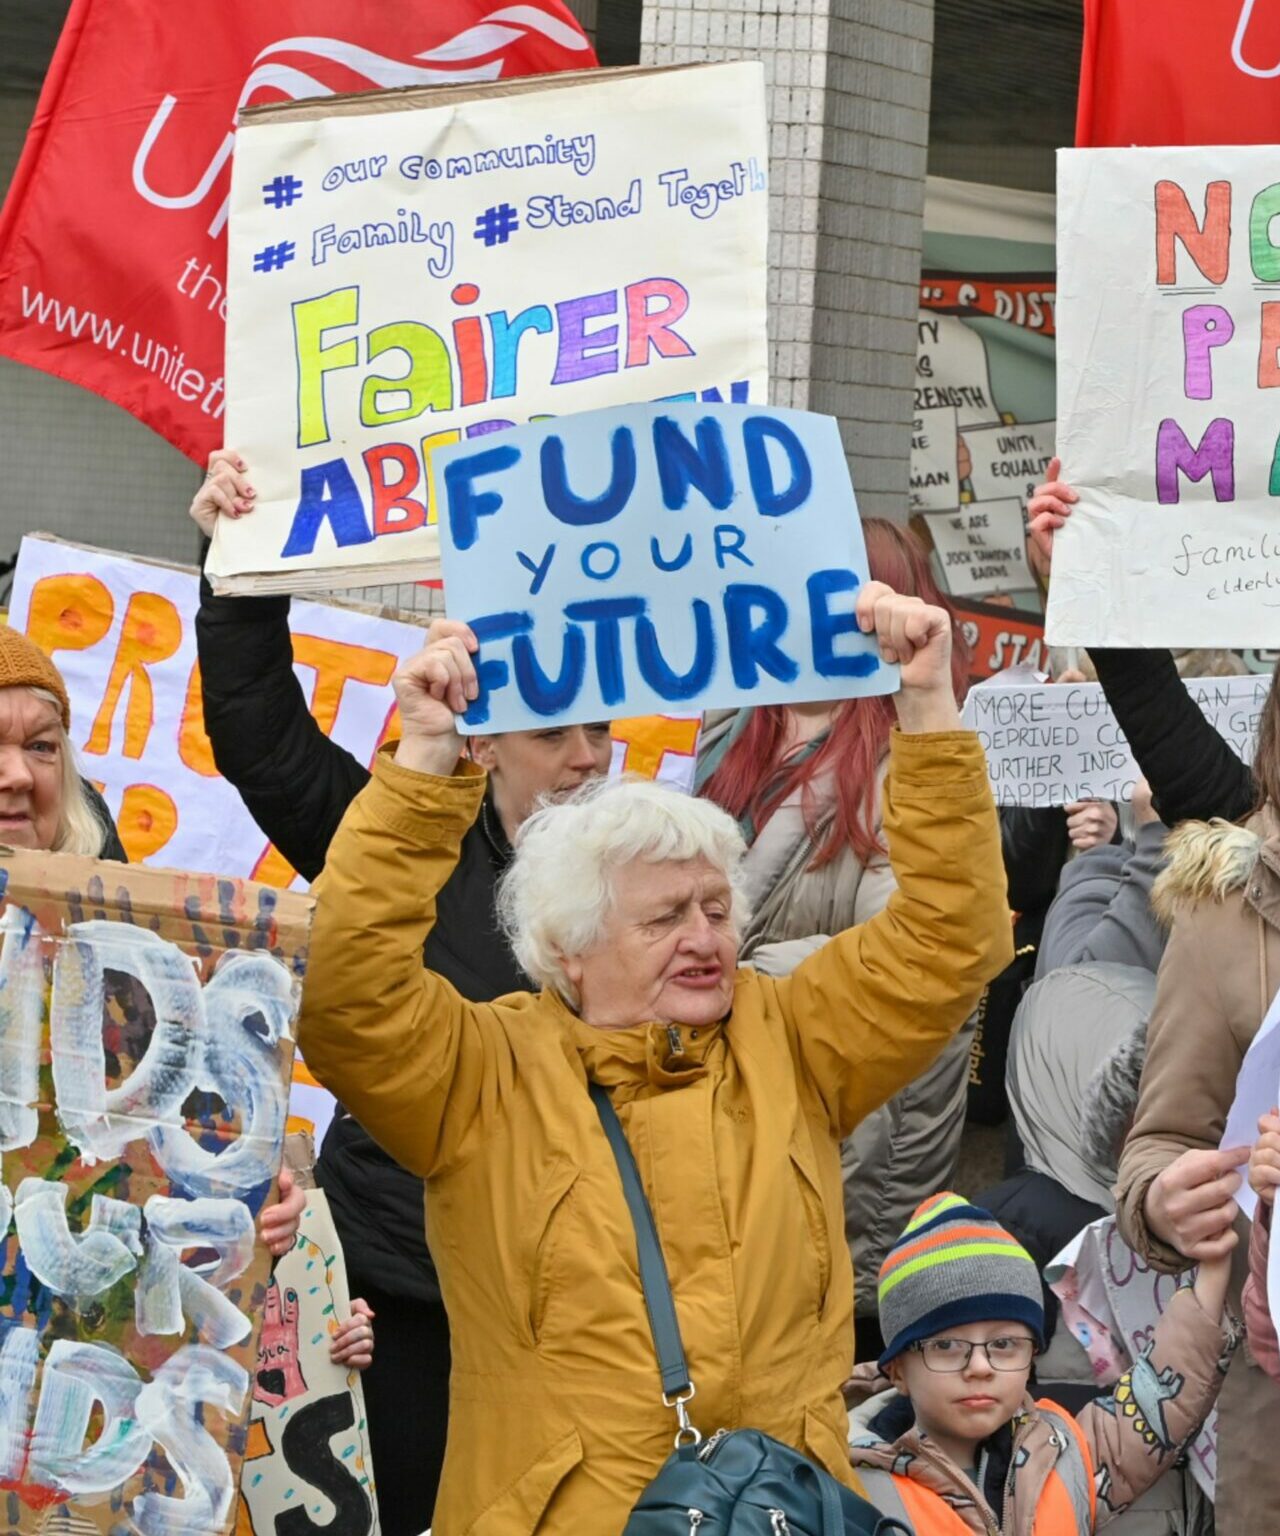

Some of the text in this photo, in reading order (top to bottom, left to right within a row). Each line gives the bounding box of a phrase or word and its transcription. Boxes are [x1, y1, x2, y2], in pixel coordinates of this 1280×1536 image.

[444, 415, 813, 550] FUND
[991, 457, 1052, 479] EQUALIT
[516, 525, 753, 595] YOUR
[463, 569, 879, 725] FUTURE
[974, 693, 1050, 727] MORE
[977, 727, 1080, 751] DEPRIVED
[986, 749, 1127, 781] URTHER INTO
[0, 1177, 255, 1349] UR
